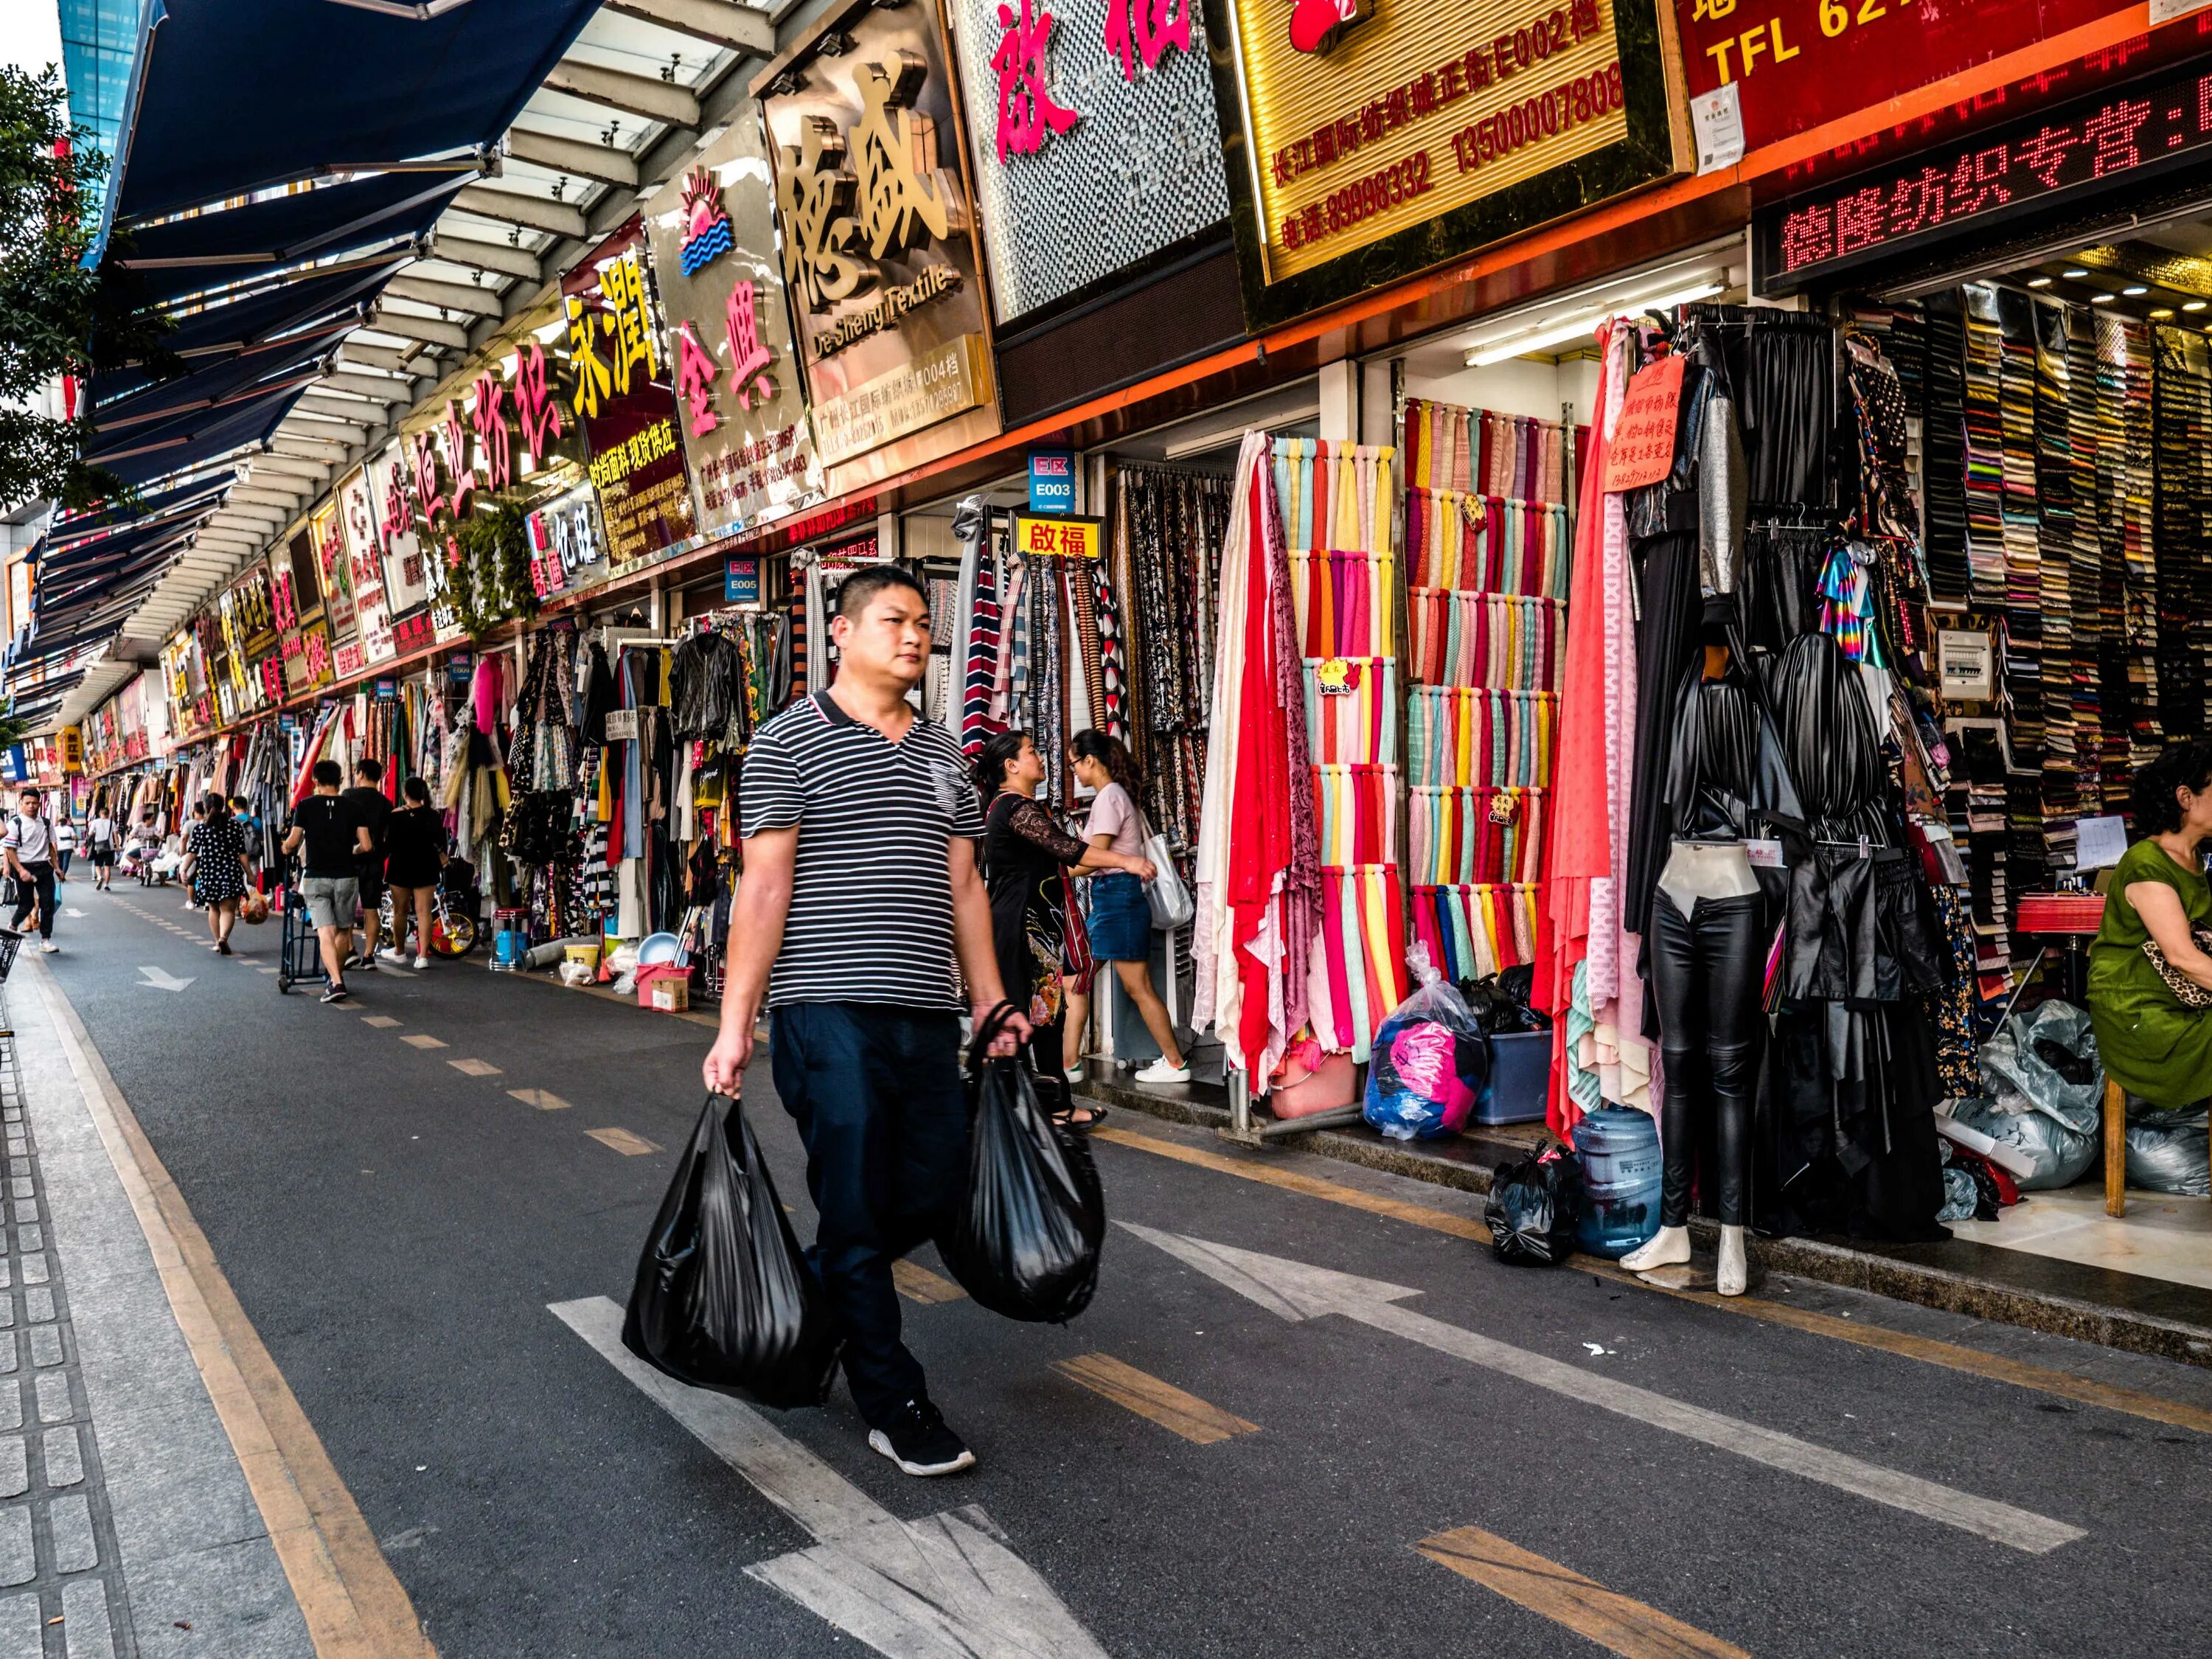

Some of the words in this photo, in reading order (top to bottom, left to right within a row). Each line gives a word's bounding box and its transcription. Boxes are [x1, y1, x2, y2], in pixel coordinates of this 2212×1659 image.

[1450, 62, 1624, 174] 13500007808
[813, 332, 832, 358] De
[833, 302, 885, 347] Sheng
[885, 265, 947, 317] Textile
[589, 442, 630, 490] 时尚面料
[627, 418, 676, 469] 现货供应
[1034, 456, 1068, 476] E区
[1036, 484, 1071, 496] E003
[729, 560, 756, 575] E区
[731, 580, 757, 590] E005
